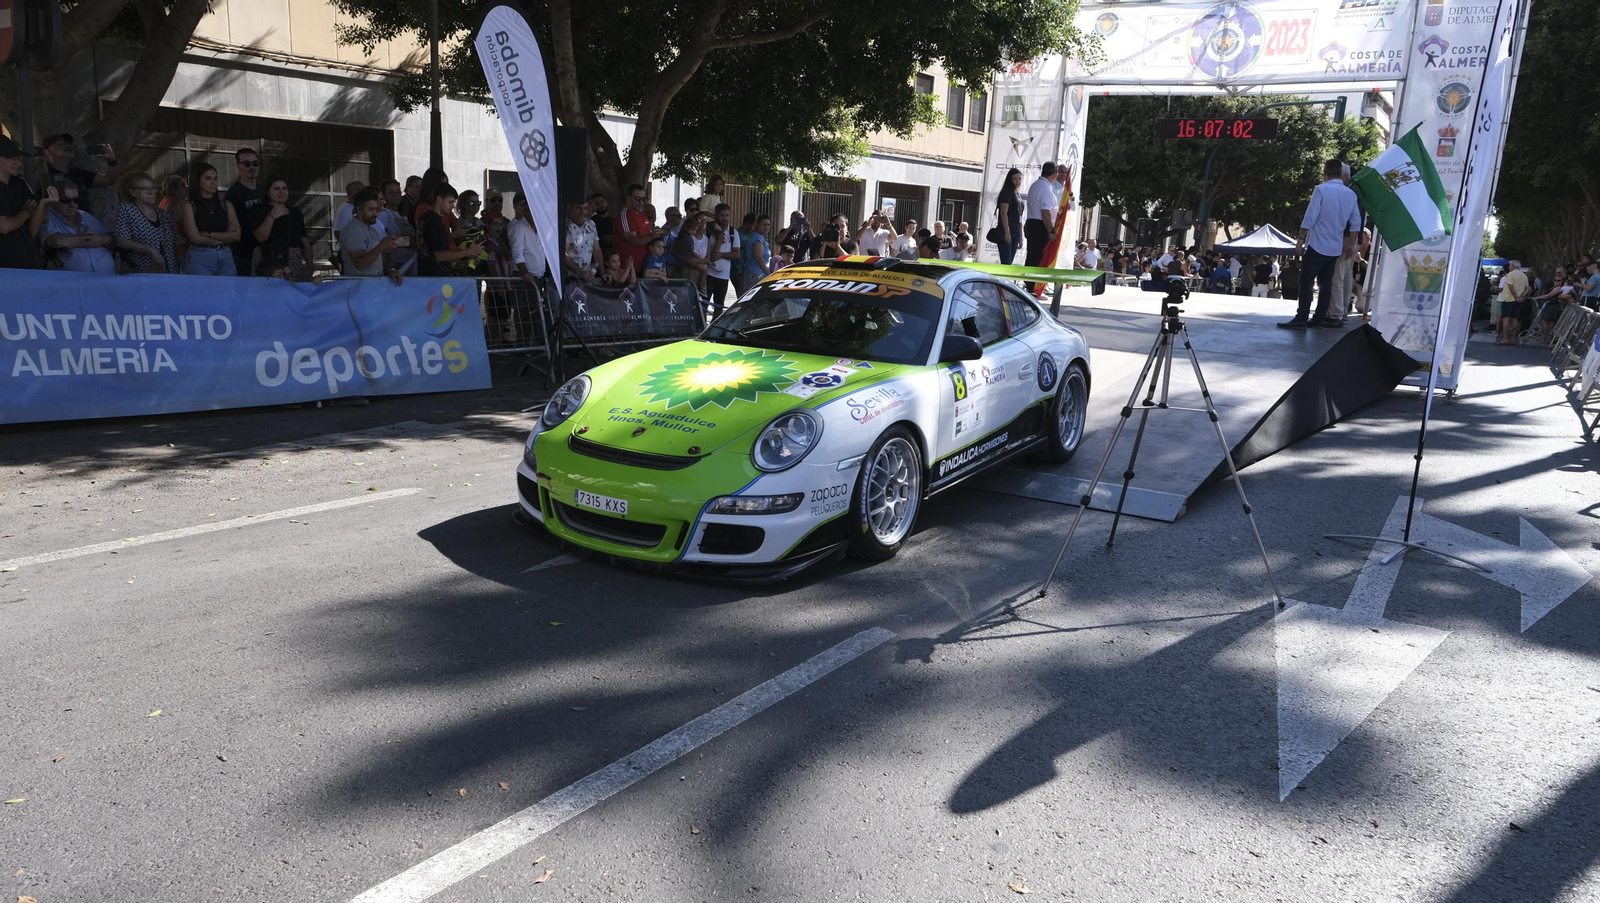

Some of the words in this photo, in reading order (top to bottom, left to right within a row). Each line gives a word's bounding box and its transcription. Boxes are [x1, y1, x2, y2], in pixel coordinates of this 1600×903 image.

[1449, 6, 1498, 16] DIPUTACI
[1264, 18, 1312, 56] 2023
[1350, 50, 1386, 60] COSTA
[1388, 50, 1403, 59] DE
[1452, 46, 1487, 55] COSTA
[1338, 59, 1402, 74] ALMERÍA
[1176, 120, 1254, 138] 16:07:02
[11, 342, 178, 378] ALMERÍA
[256, 336, 468, 394] deportes
[953, 372, 966, 400] 8
[846, 386, 902, 421] Sevilla
[607, 415, 646, 424] Hnos.
[650, 420, 700, 434] Mullor
[638, 409, 716, 429] Aguadulce
[944, 445, 978, 473] INDALICA
[580, 492, 601, 508] 7315
[606, 499, 626, 513] KXS
[810, 484, 848, 504] zapata
[810, 499, 847, 516] PELUQUEROS
